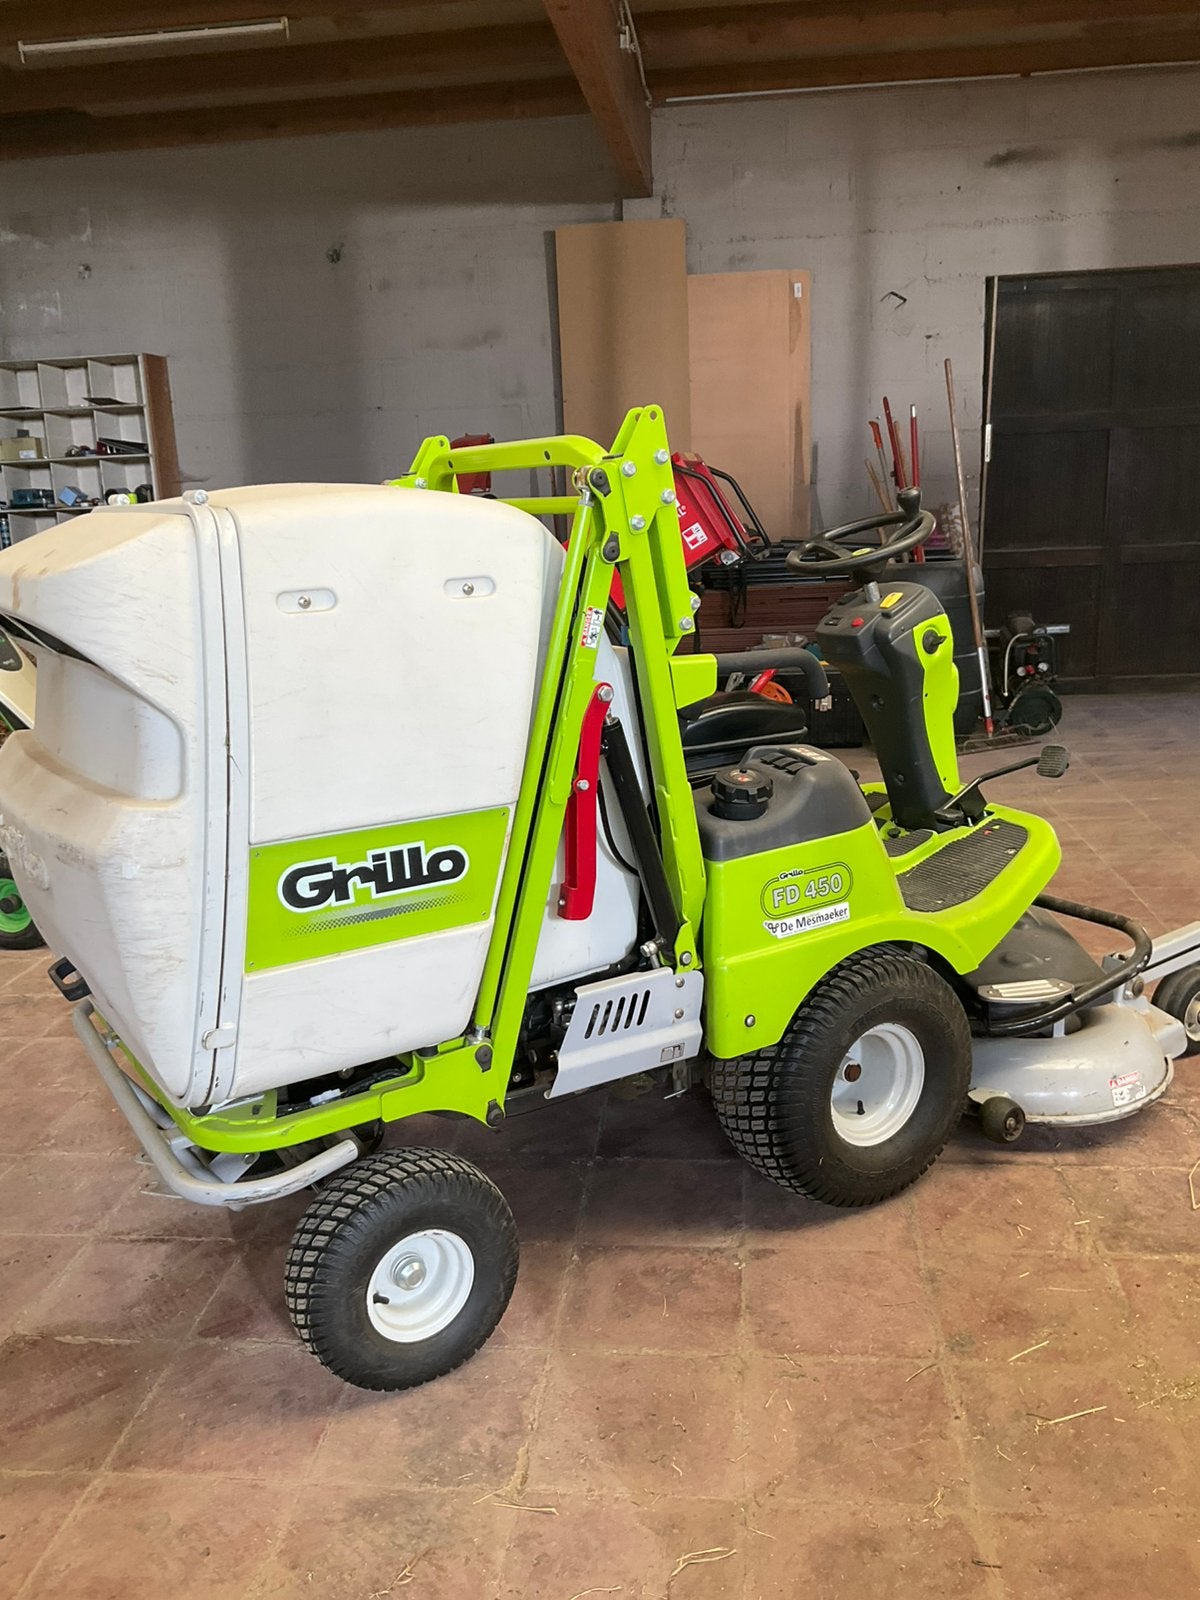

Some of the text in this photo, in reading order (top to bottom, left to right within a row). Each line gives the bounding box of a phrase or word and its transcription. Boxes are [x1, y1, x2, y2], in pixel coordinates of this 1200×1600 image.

[281, 845, 466, 909] Grillo
[772, 872, 843, 909] FD 450
[779, 869, 804, 880] Grillo
[780, 921, 794, 934] De
[795, 907, 848, 929] Mesmaeker
